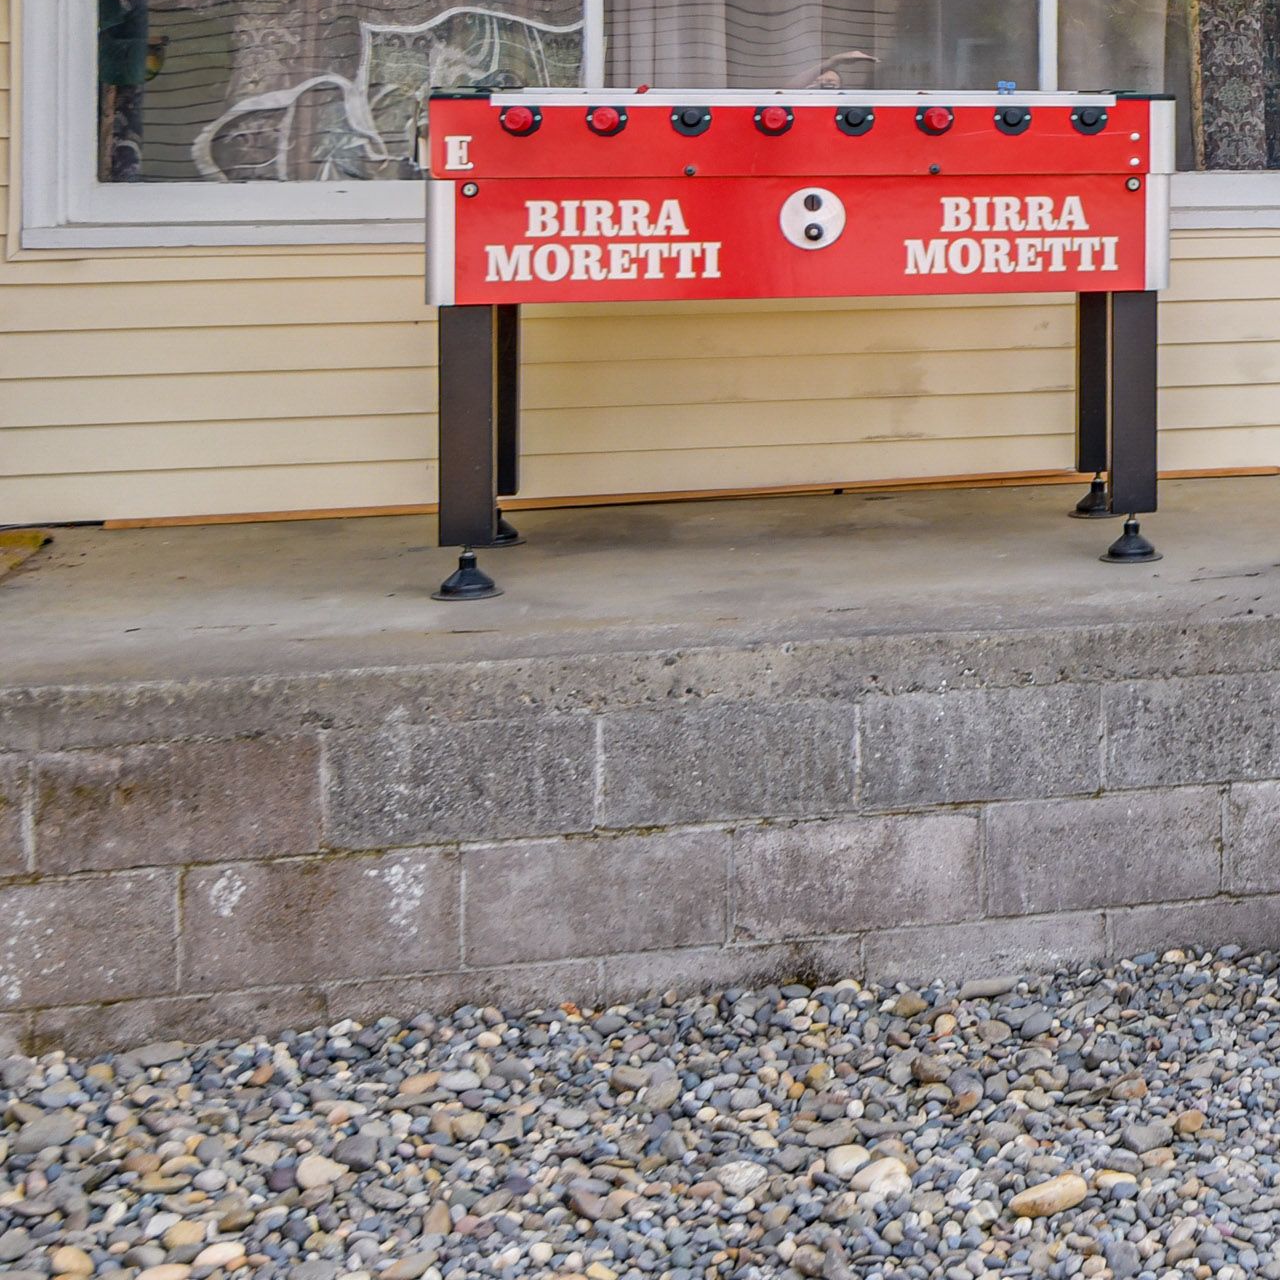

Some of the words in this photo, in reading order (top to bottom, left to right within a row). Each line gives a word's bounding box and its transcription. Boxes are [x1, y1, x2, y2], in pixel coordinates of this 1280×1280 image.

[524, 199, 690, 238] BIRRA
[940, 195, 1089, 232] BIRRA
[484, 241, 722, 282] MORETTI
[903, 236, 1119, 275] MORETTI
